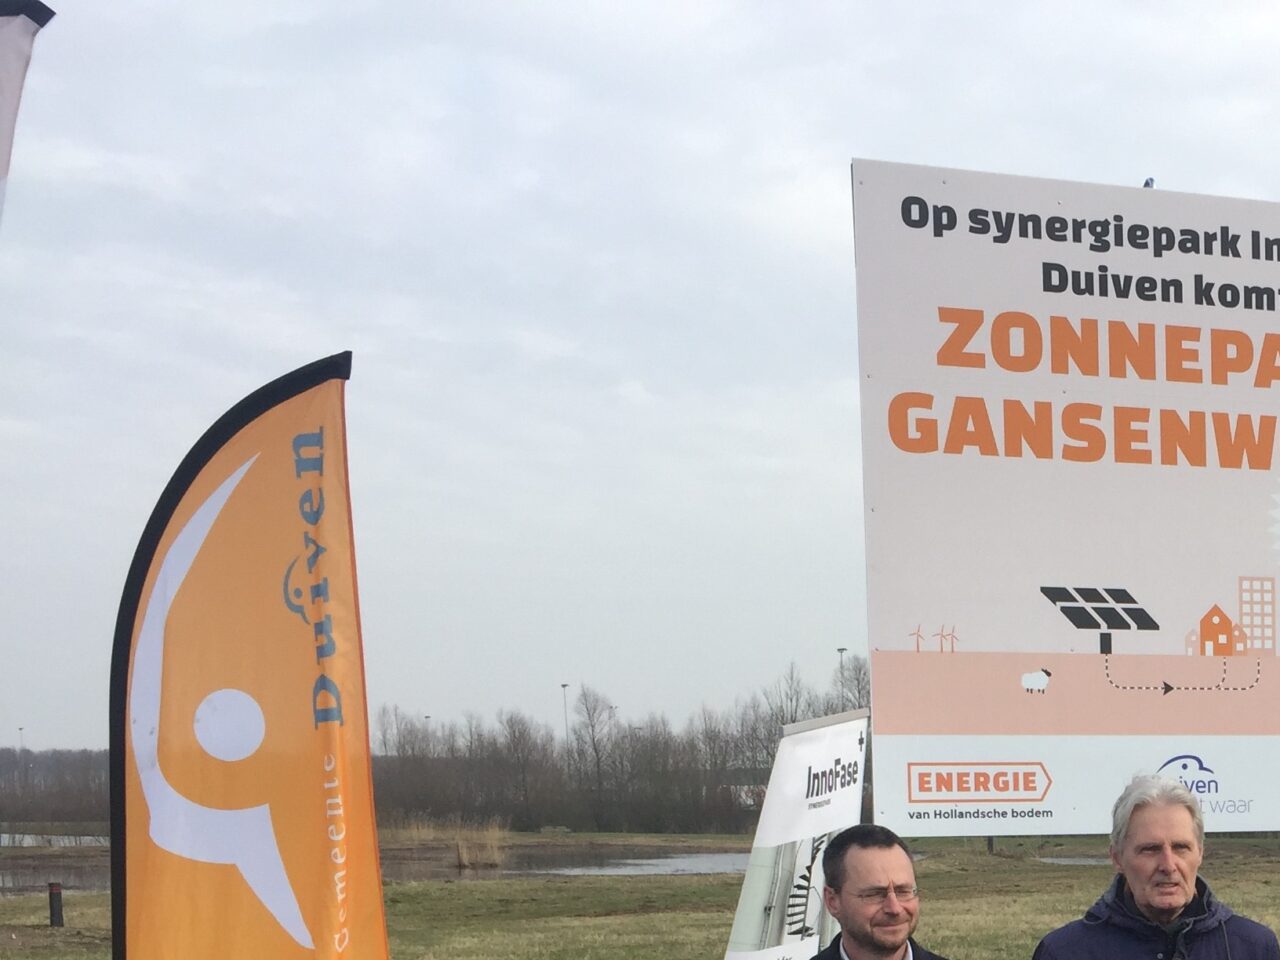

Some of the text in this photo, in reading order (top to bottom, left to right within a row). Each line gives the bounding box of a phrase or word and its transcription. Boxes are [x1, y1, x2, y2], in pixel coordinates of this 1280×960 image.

[900, 195, 958, 238] Op
[968, 202, 1242, 260] synergiepark
[1041, 261, 1184, 304] Duiven
[292, 425, 345, 731] Duiven
[805, 757, 859, 800] InnoFase
[917, 770, 1039, 794] ENERGIE
[907, 807, 1054, 821] van Hollandsche bodem
[1209, 799, 1254, 814] waar
